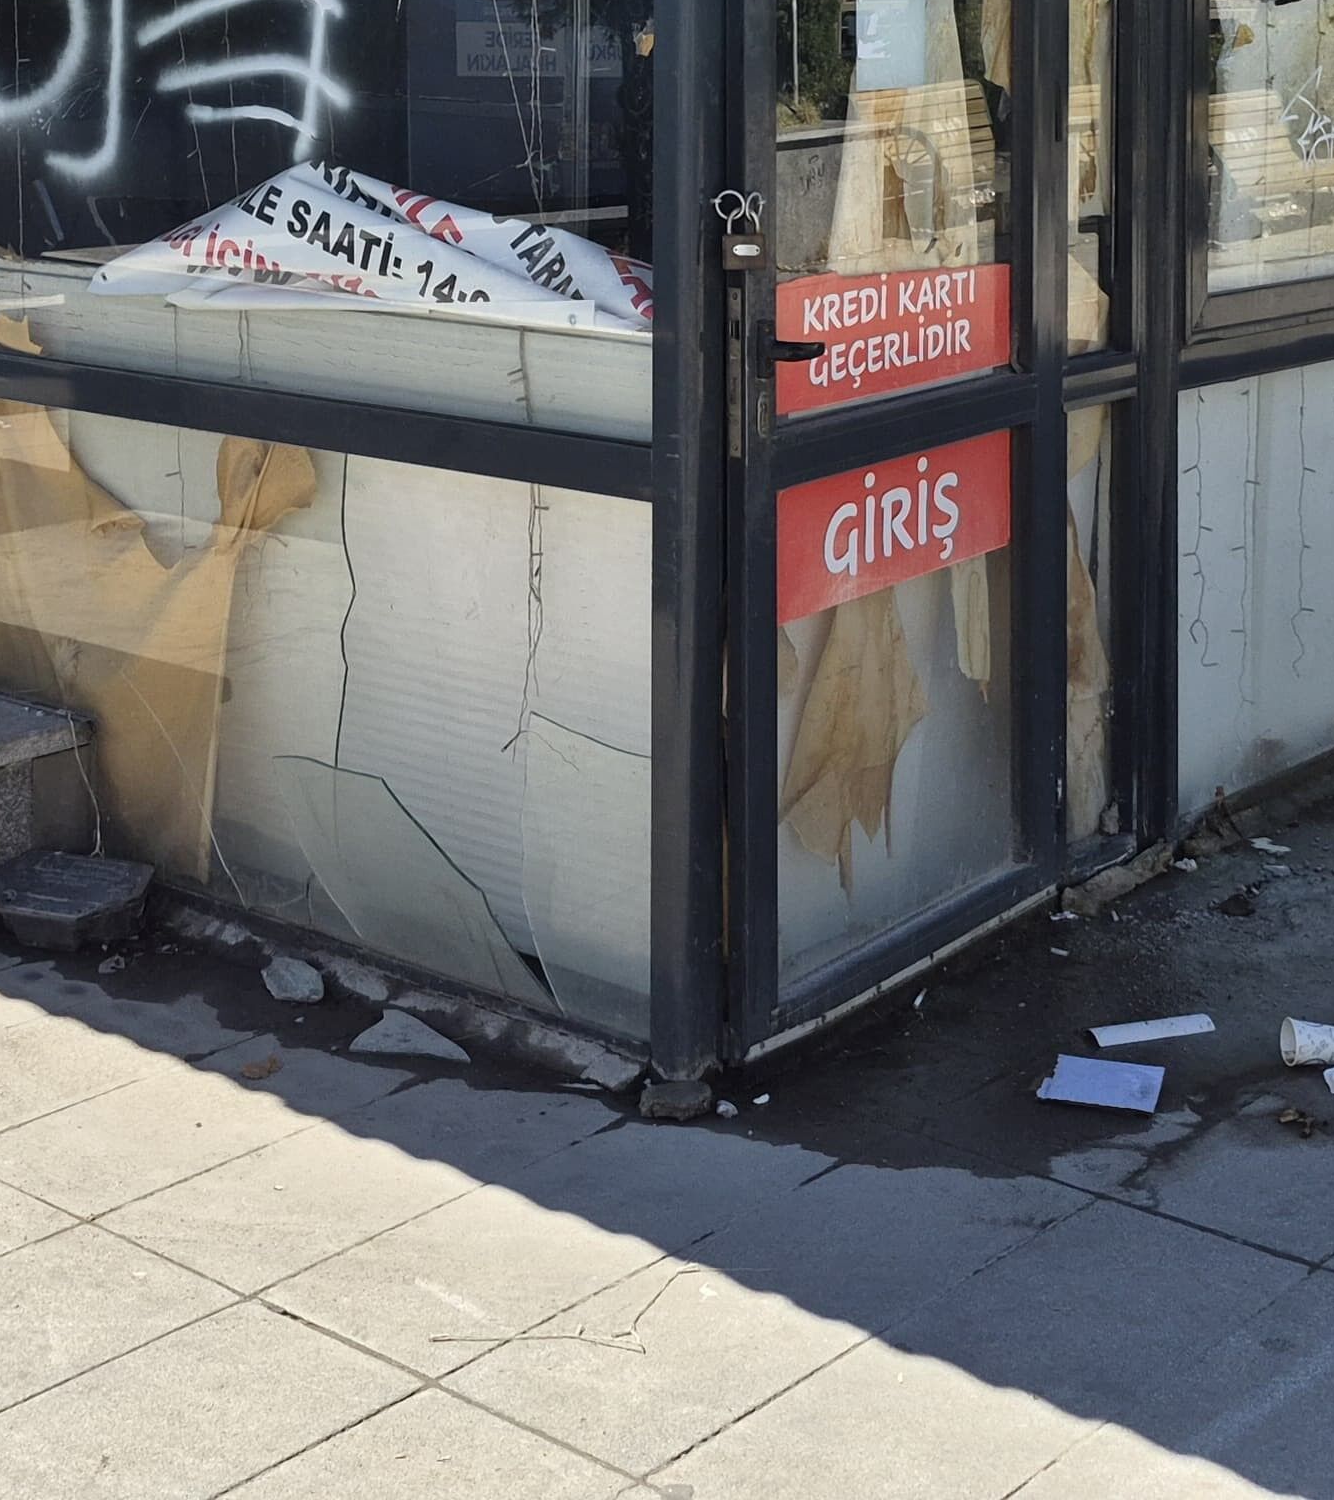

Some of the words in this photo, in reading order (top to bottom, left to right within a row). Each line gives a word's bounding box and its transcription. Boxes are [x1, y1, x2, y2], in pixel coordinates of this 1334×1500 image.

[287, 199, 404, 280] SAATİ:
[803, 273, 888, 335] KREDİ
[898, 269, 976, 319] KARTI
[808, 310, 972, 389] GEÇERLİDİR
[823, 456, 960, 577] GİRİŞ
